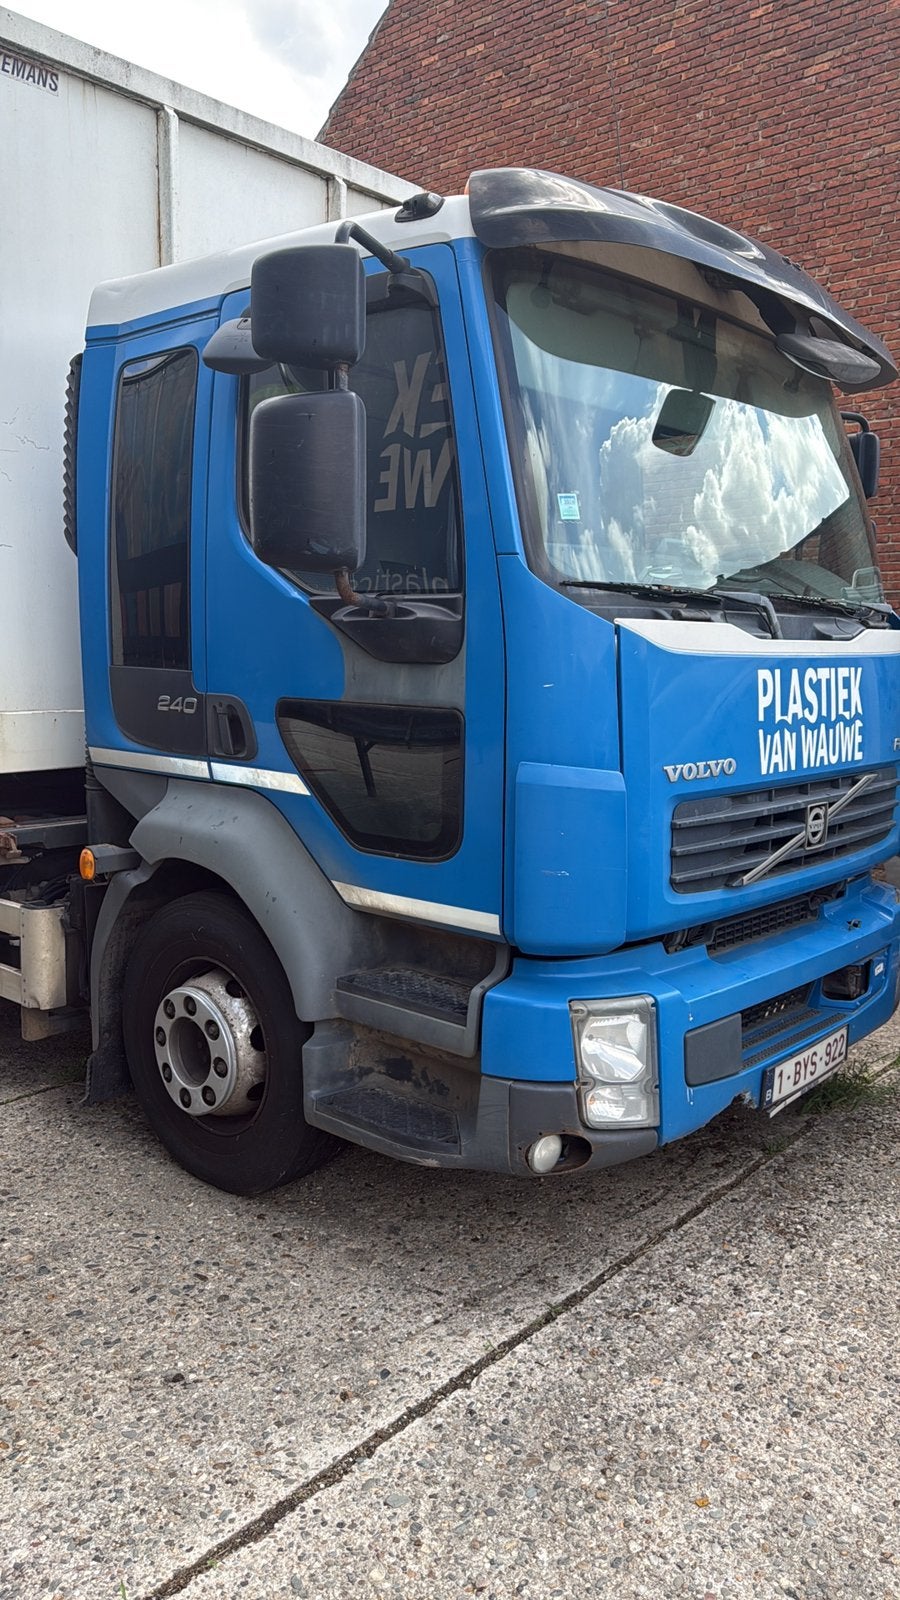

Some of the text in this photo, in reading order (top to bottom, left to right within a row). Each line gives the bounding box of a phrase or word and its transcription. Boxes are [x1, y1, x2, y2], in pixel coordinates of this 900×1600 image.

[0, 51, 59, 92] EMANS
[157, 694, 198, 714] 240
[756, 666, 863, 725] PLASTIEK
[758, 719, 864, 776] VAN WAUWE
[663, 757, 737, 783] VOLVO
[777, 1033, 845, 1095] 1-BYS-922
[765, 1088, 773, 1101] B
